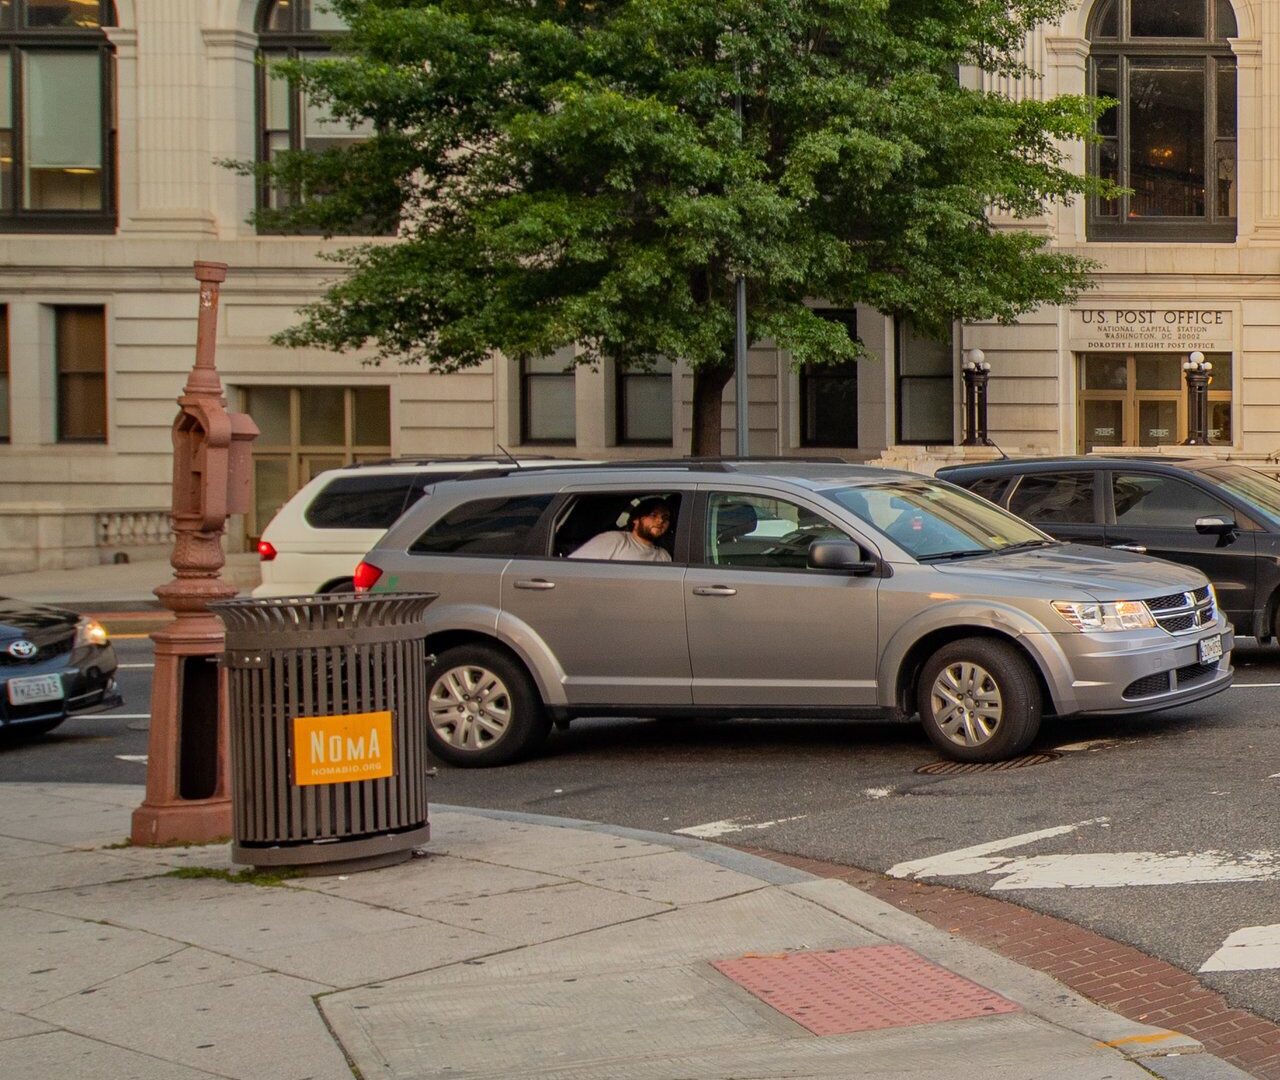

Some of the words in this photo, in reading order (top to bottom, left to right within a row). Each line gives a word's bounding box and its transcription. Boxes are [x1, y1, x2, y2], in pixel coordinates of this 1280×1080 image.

[1081, 310, 1109, 324] U.S.
[1116, 310, 1157, 324] POST
[1163, 310, 1224, 325] OFFICE
[1167, 342, 1186, 350] POST
[1187, 342, 1216, 350] OFFICE
